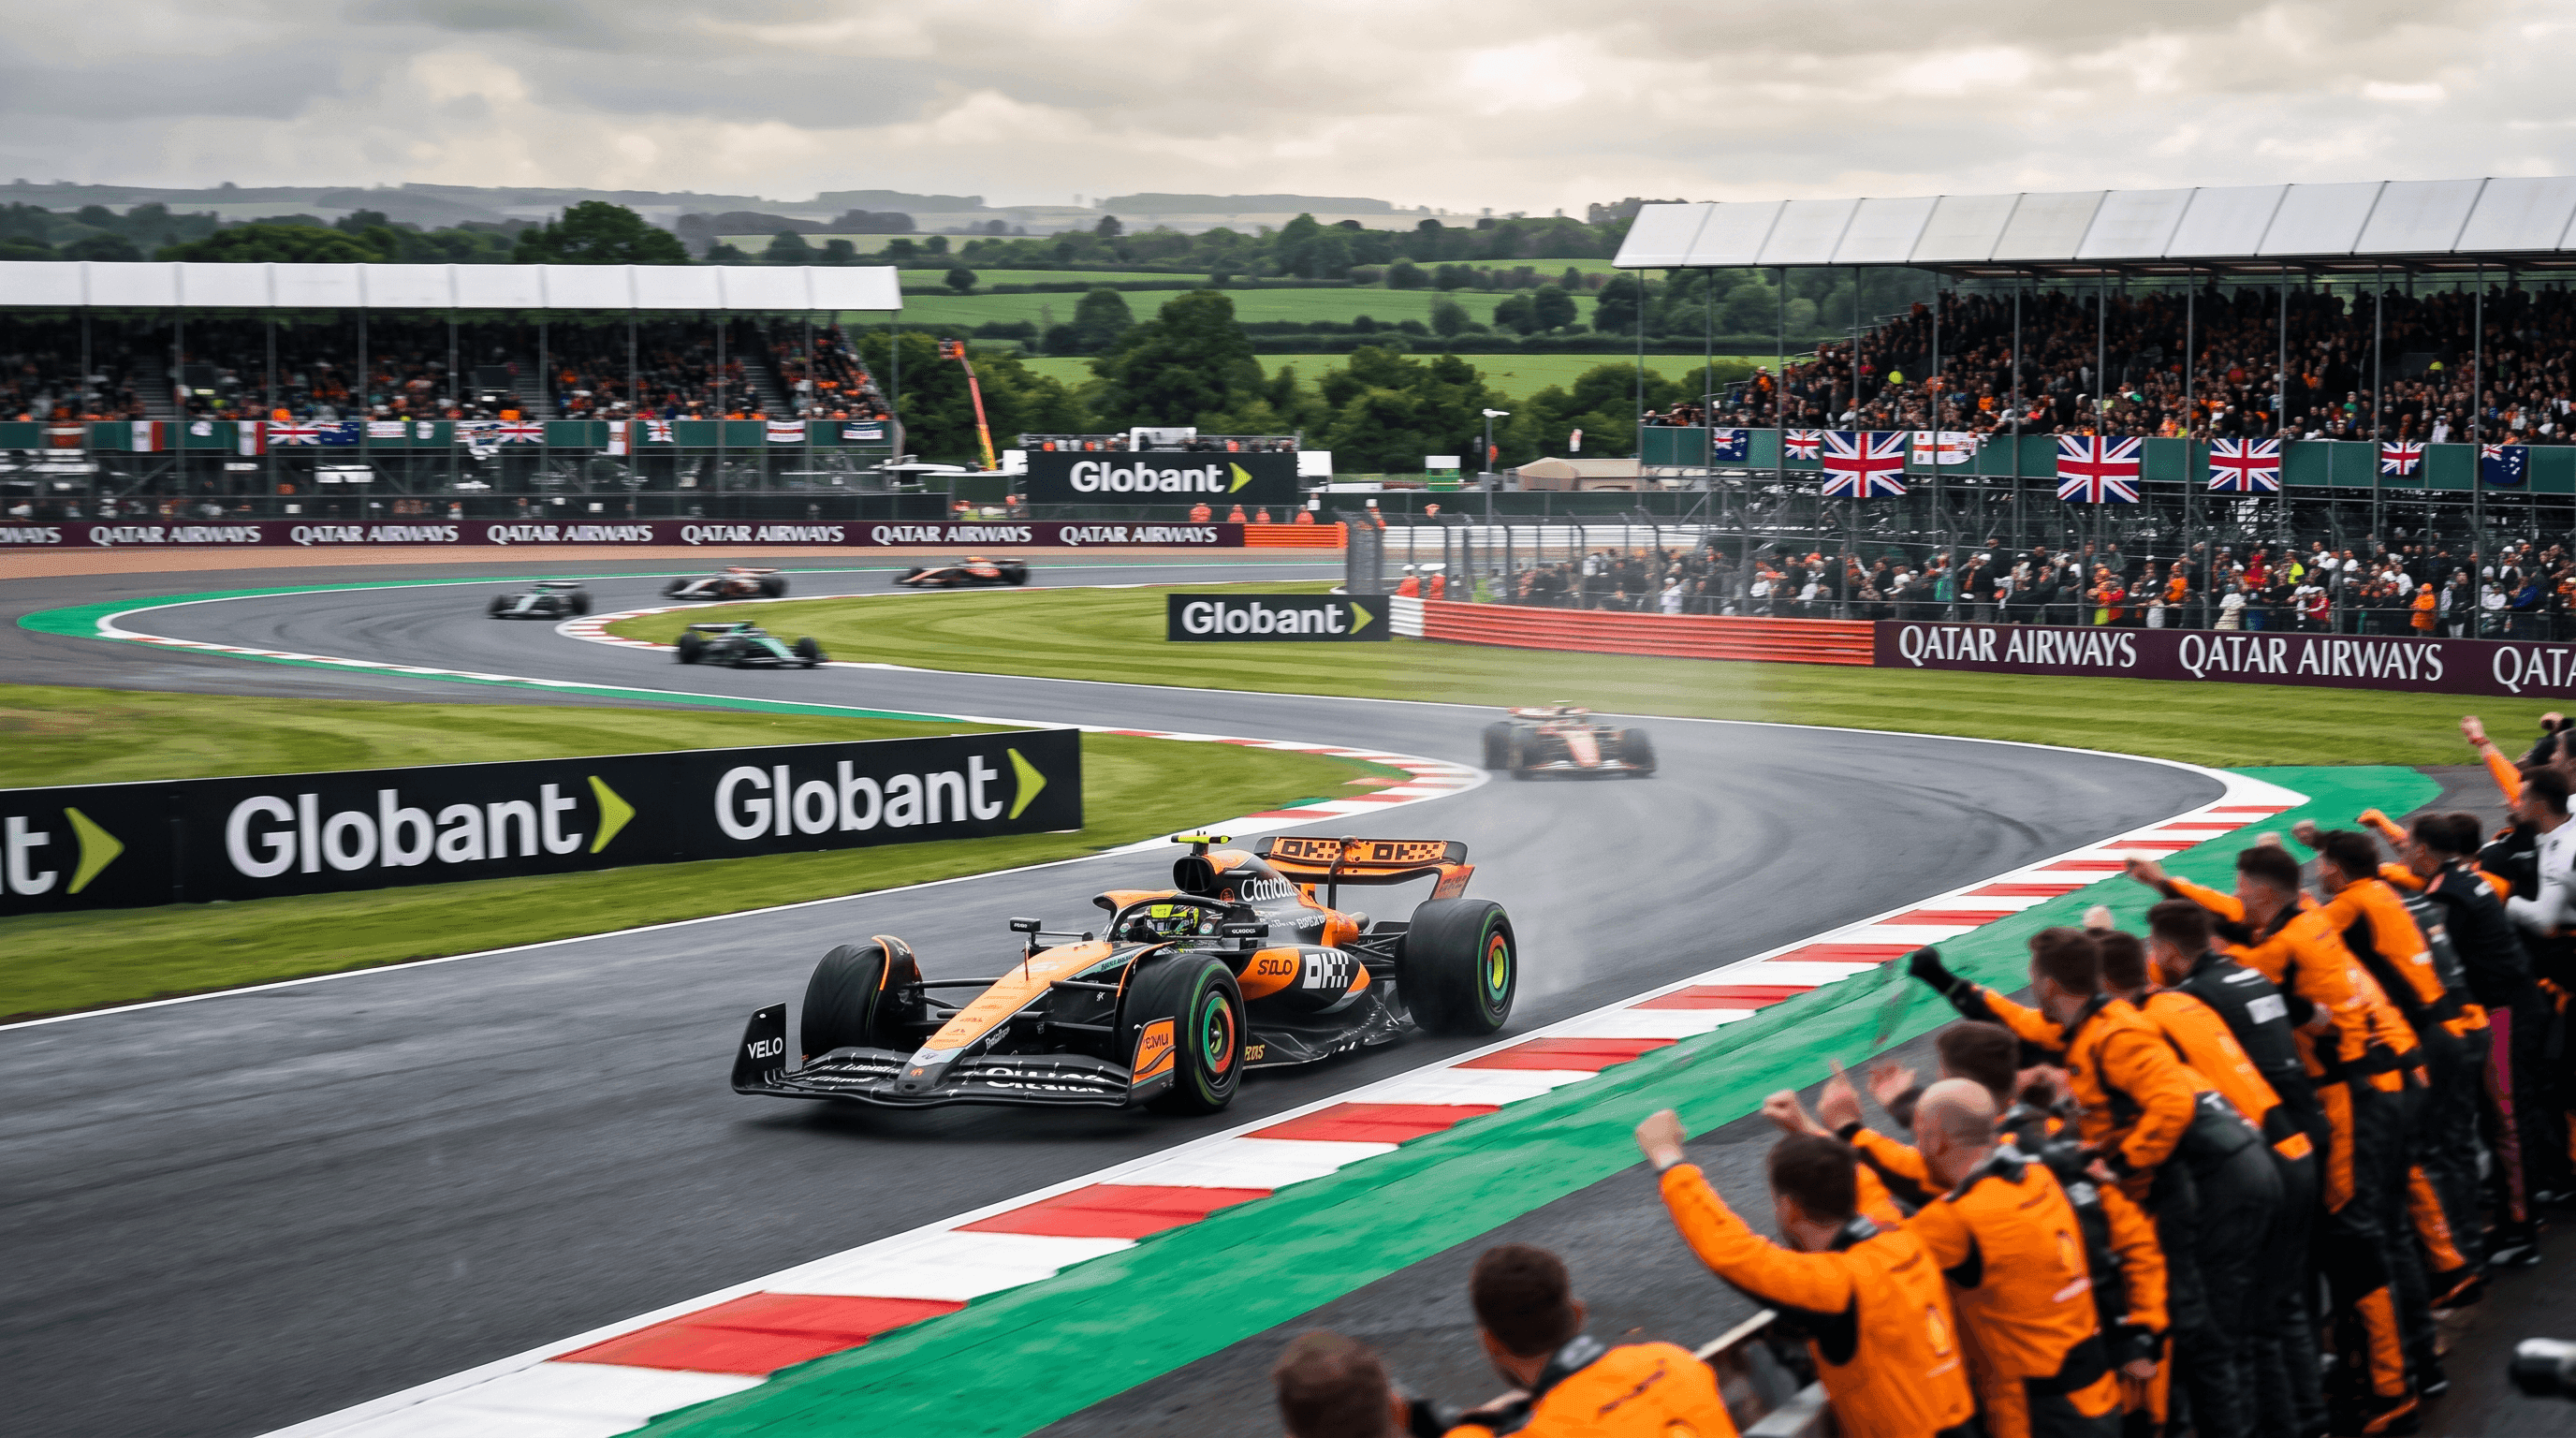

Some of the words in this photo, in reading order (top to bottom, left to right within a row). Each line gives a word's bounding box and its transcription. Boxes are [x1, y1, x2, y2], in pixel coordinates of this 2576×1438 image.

[1070, 461, 1225, 493] Globant
[0, 527, 62, 543] WAYS
[90, 526, 166, 546] QATAR
[168, 526, 262, 543] AIRWAYS
[290, 525, 364, 546] QATAR
[366, 525, 460, 542] AIRWAYS
[487, 525, 560, 545] QATAR
[562, 525, 653, 542] AIRWAYS
[681, 525, 752, 545] QATAR
[754, 525, 844, 542] AIRWAYS
[871, 525, 942, 546] QATAR
[944, 526, 1032, 543] AIRWAYS
[1060, 526, 1129, 546] QATAR
[1131, 526, 1218, 543] AIRWAYS
[1181, 601, 1346, 634] Globant
[1898, 625, 1998, 667] QATAR
[2004, 628, 2137, 668] AIRWAYS
[2179, 634, 2289, 679] QATAR
[2296, 638, 2443, 682] AIRWAYS
[714, 756, 1004, 841] Globant
[225, 783, 583, 878] Globant
[747, 1036, 783, 1060] VELO
